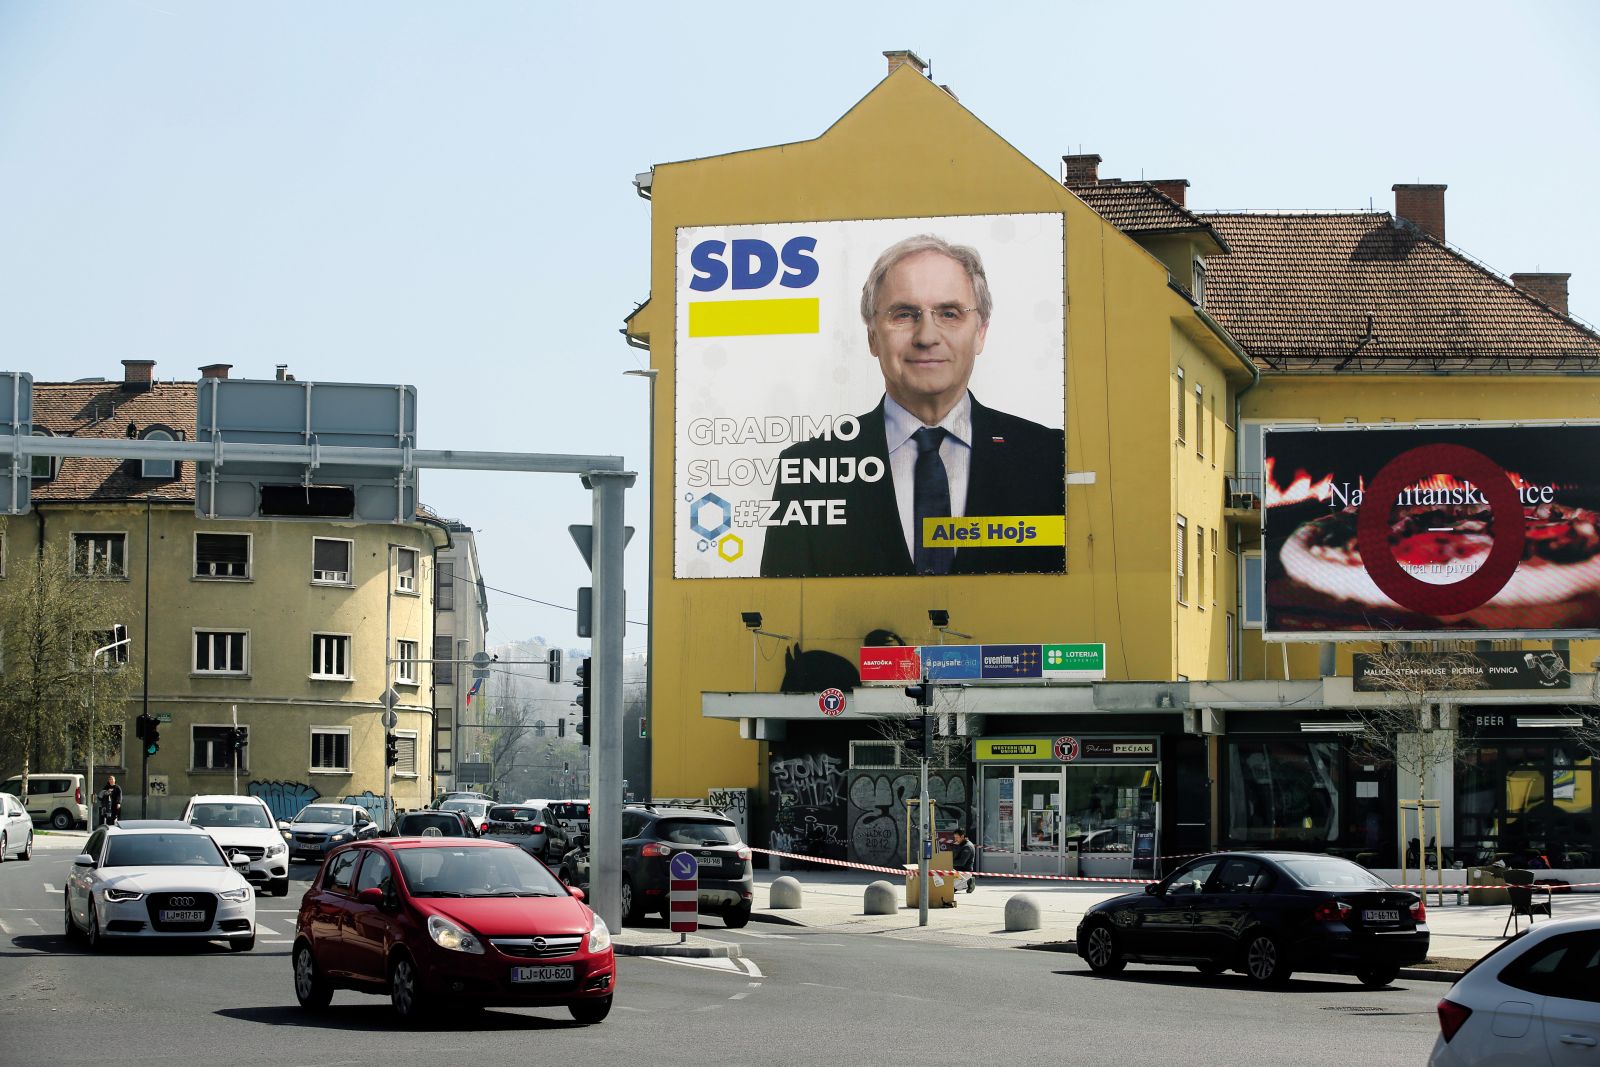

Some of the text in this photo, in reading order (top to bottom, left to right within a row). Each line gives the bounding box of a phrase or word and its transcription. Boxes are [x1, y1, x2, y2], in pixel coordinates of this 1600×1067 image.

[689, 236, 820, 292] SDS
[687, 413, 861, 446] GRADIMO
[687, 456, 885, 488] SLOVENIJO
[733, 499, 848, 528] #ZATE
[931, 520, 1038, 544] Aleš Hojs
[984, 654, 1020, 665] eventim.si
[1363, 668, 1391, 676] MALICE
[1395, 668, 1419, 676] STEAK
[1451, 667, 1484, 675] PICERIJA
[1489, 666, 1518, 674] PIVNICA
[827, 698, 836, 709] T
[1476, 713, 1504, 726] BEER
[1062, 745, 1071, 755] T
